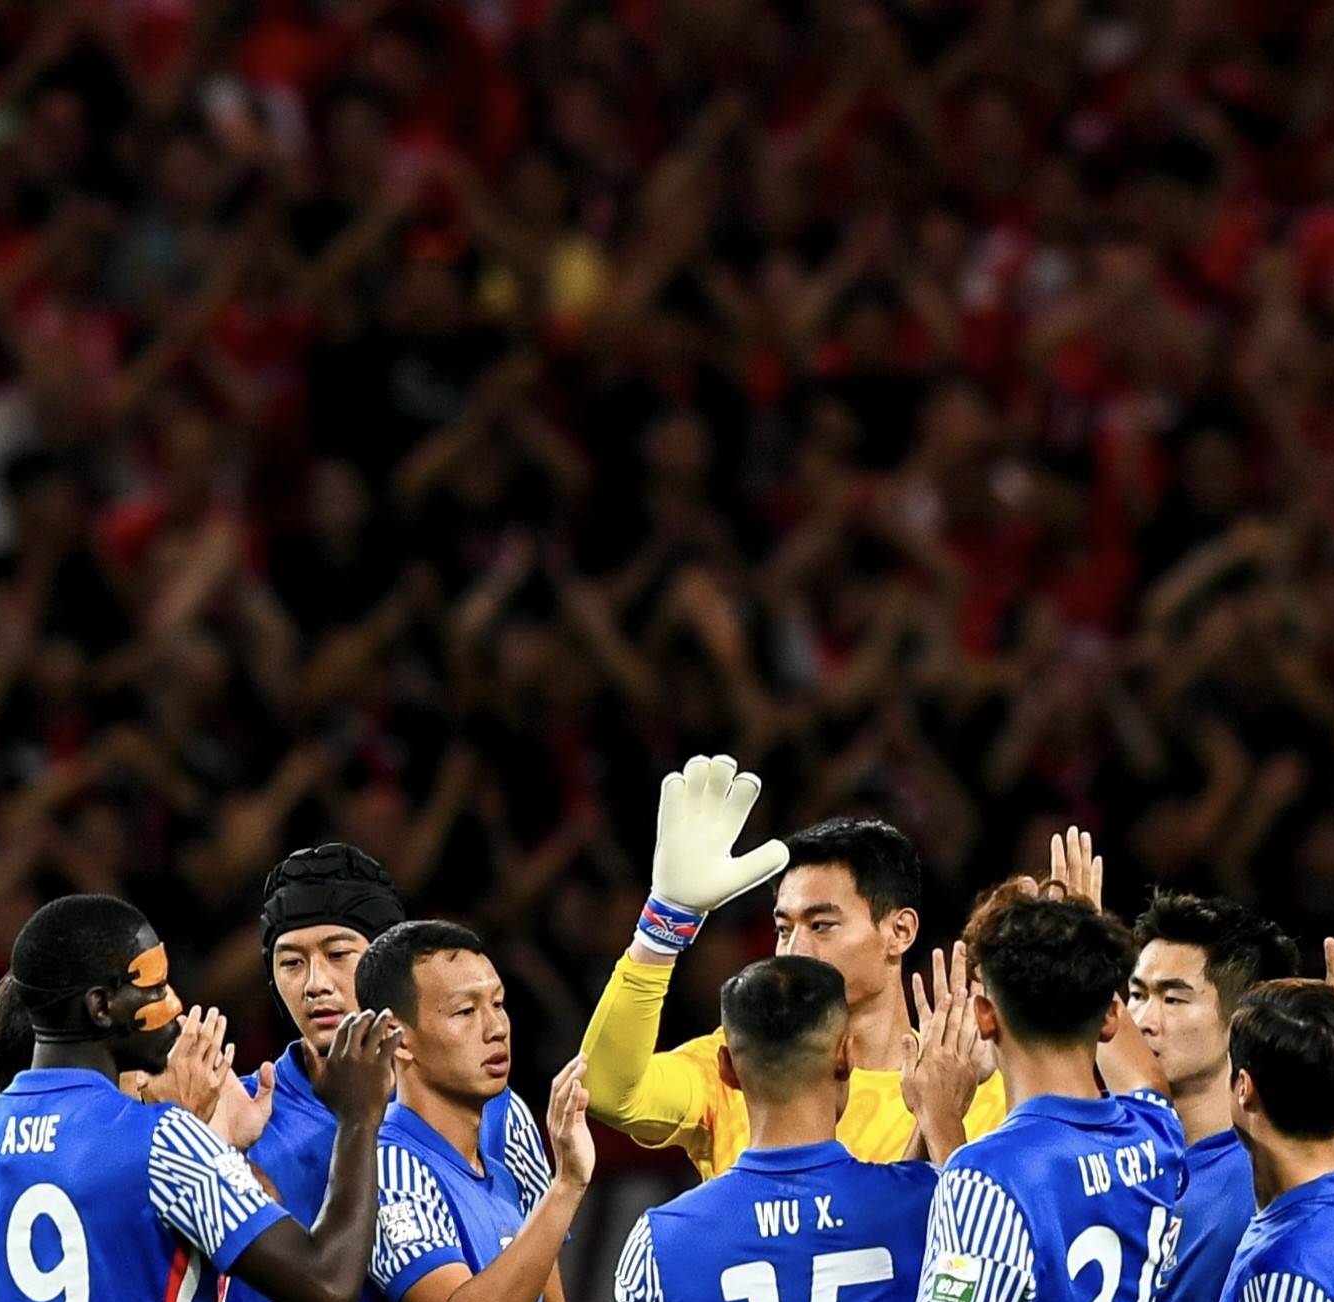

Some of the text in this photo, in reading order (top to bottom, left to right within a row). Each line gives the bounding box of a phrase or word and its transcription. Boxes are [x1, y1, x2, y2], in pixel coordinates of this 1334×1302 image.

[0, 1114, 60, 1155] ASUE
[1078, 1153, 1111, 1197] LIU
[754, 1195, 844, 1238] WU X.
